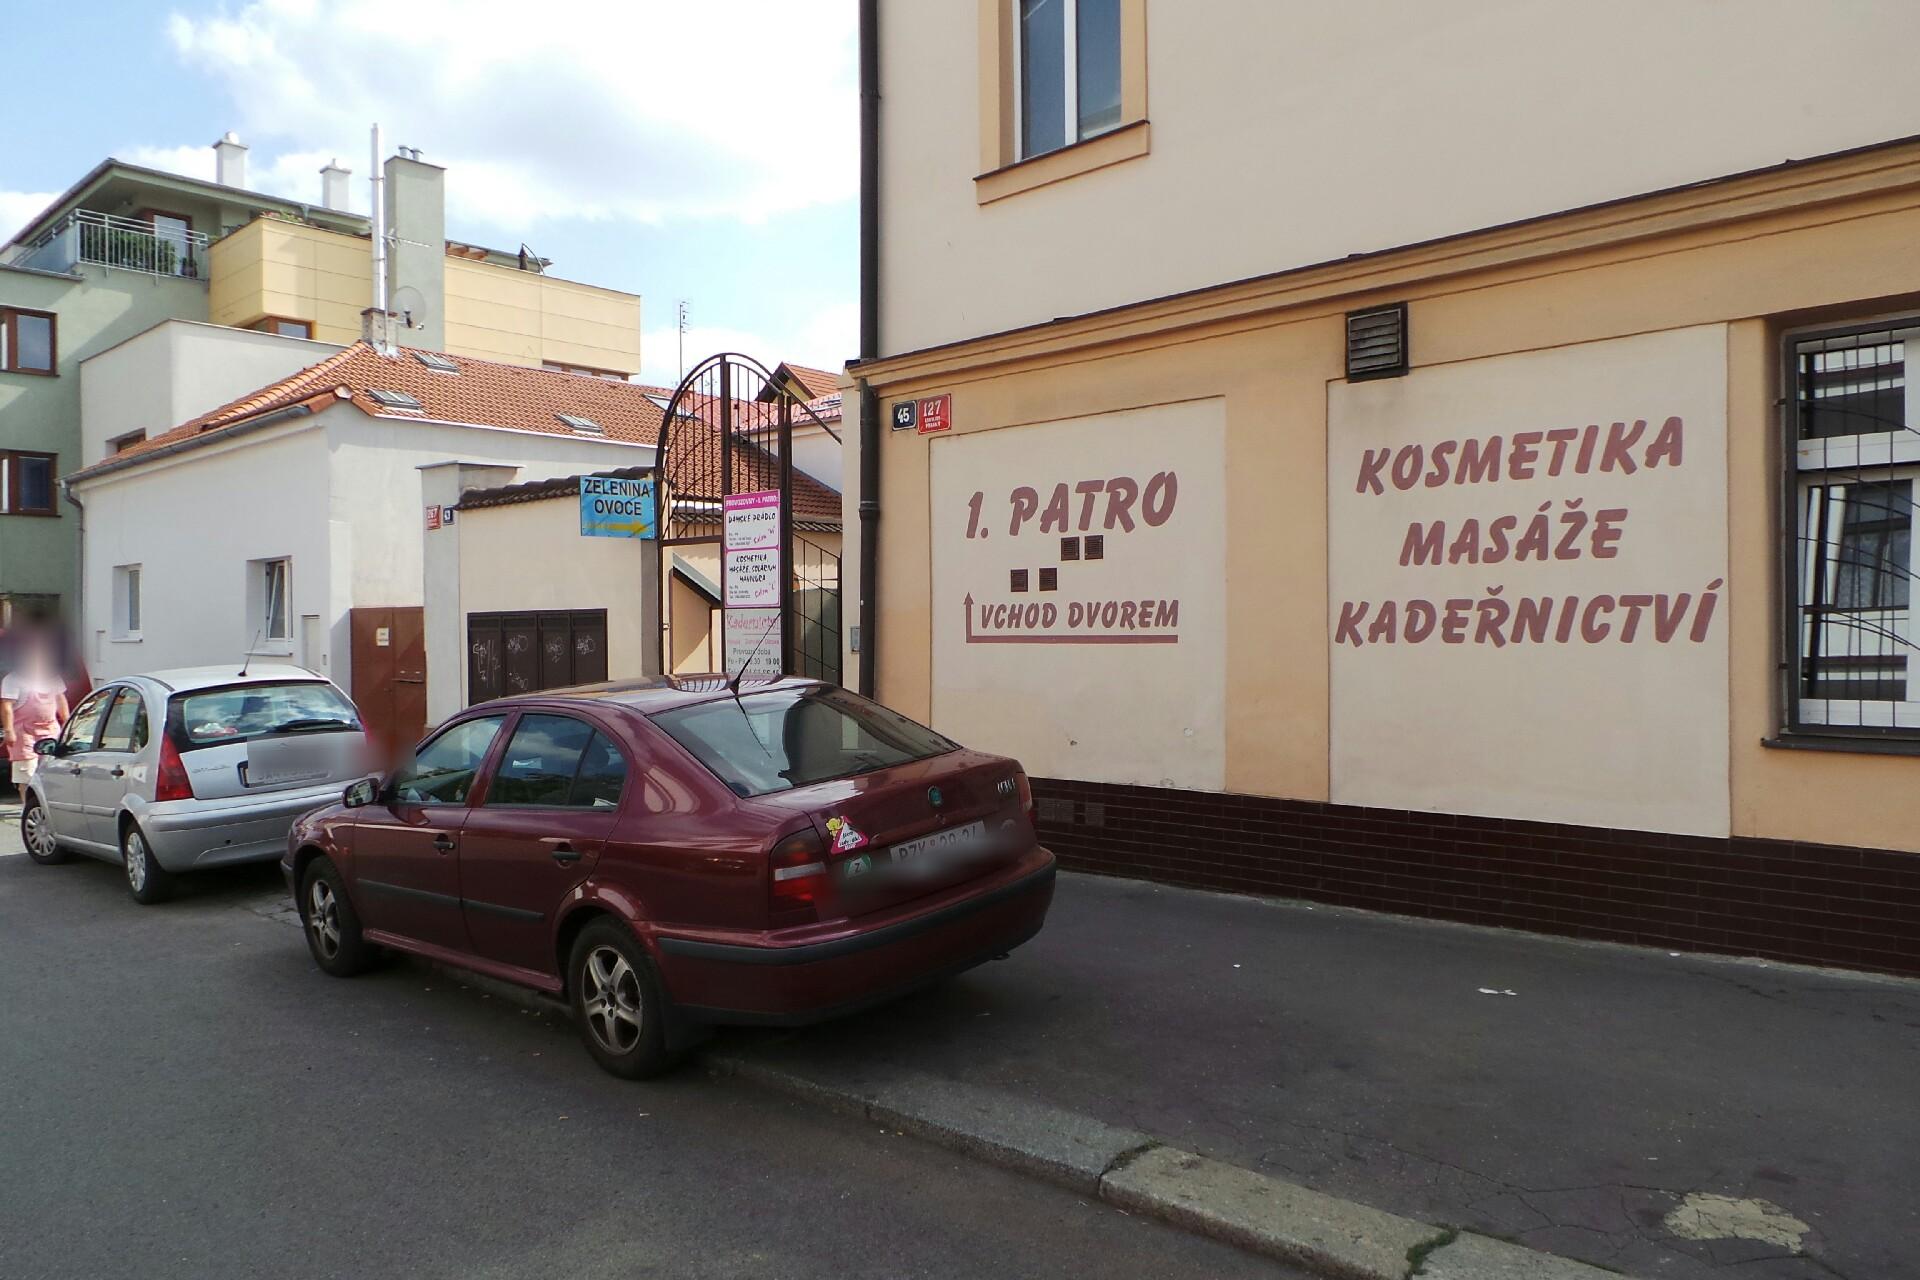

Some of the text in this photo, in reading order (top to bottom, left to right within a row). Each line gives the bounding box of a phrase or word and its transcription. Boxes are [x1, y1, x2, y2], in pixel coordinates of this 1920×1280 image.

[897, 407, 910, 423] 45
[923, 400, 942, 417] 127
[1356, 416, 1683, 495] KOSMETIKA
[584, 478, 650, 498] ZELENINA
[594, 499, 642, 516] OVOCE
[966, 471, 1178, 538] 1. PATRO
[1399, 497, 1629, 567] MASÁŽE
[981, 599, 1178, 630] VCHOD DVOREM
[1334, 578, 1723, 648] KADEŘNICTVÍ
